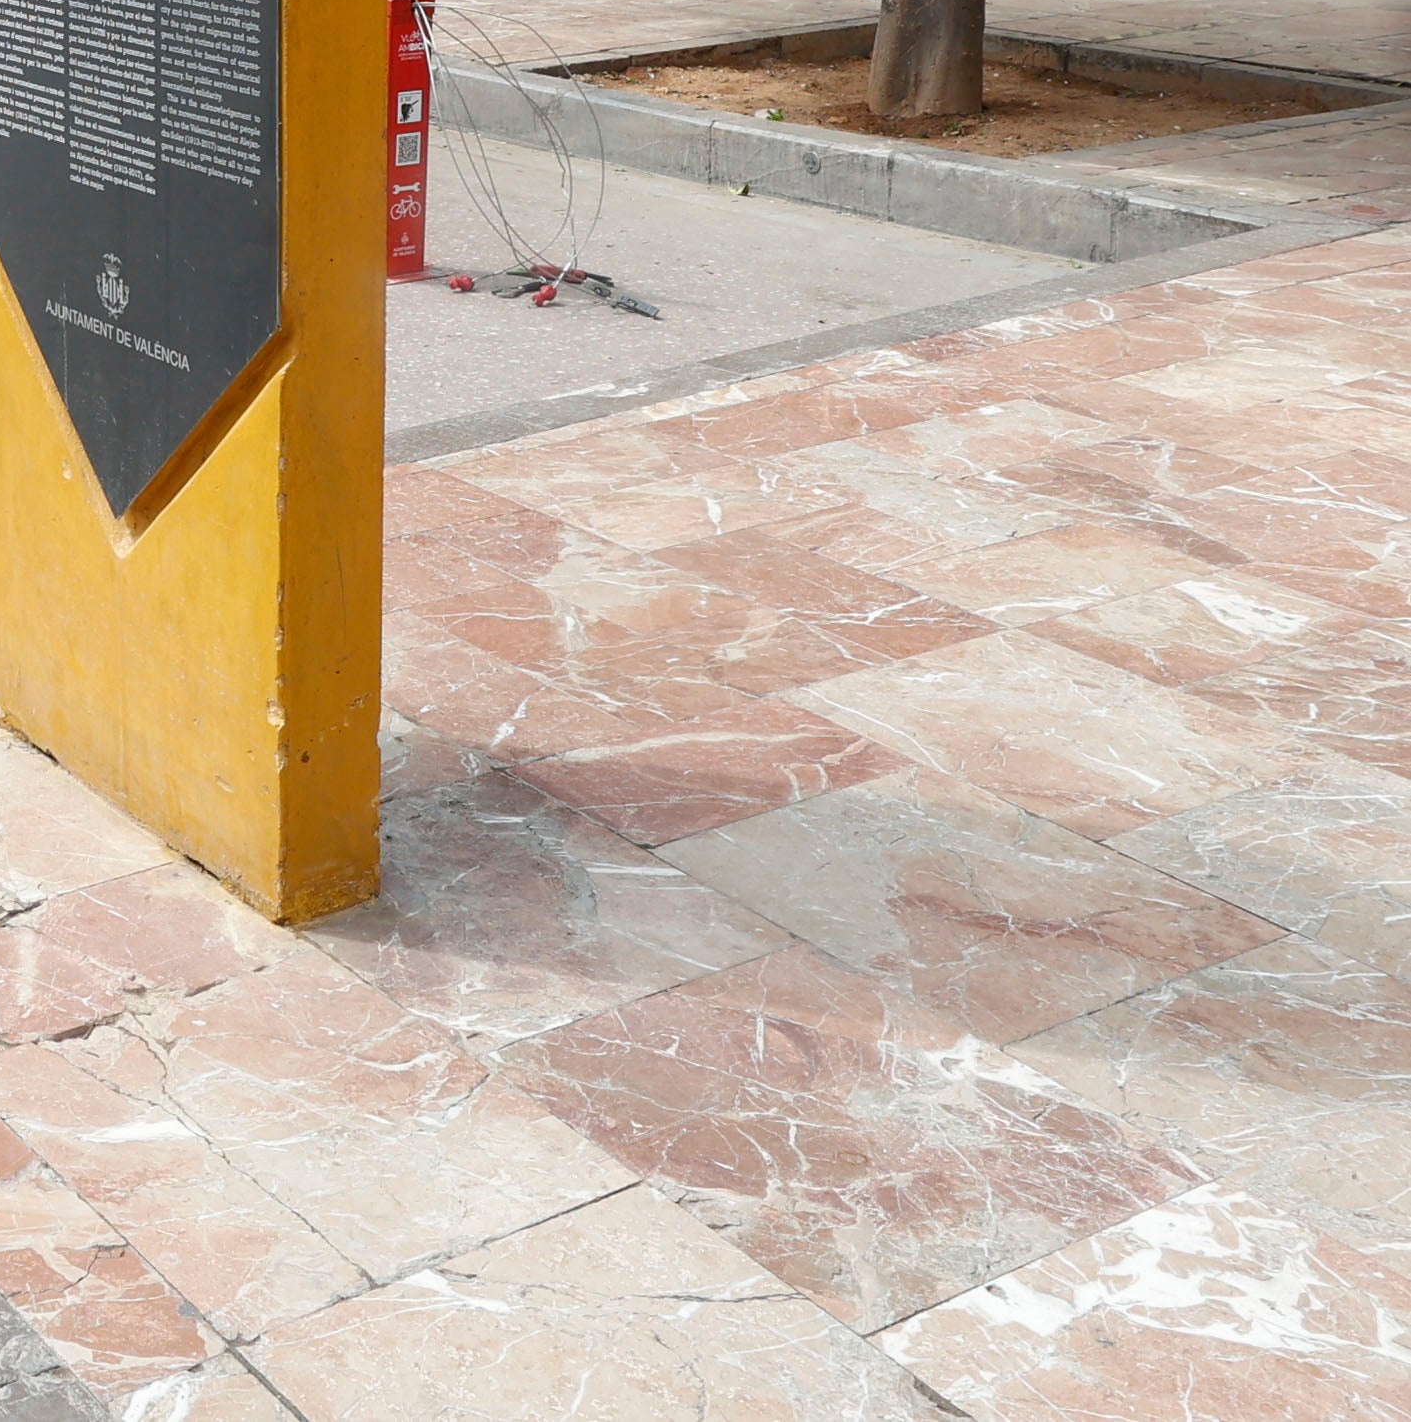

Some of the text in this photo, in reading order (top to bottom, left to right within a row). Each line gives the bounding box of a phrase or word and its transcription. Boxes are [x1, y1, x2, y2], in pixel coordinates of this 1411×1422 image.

[45, 299, 190, 372] AJUNTAMENT DE VALÈNCIA
